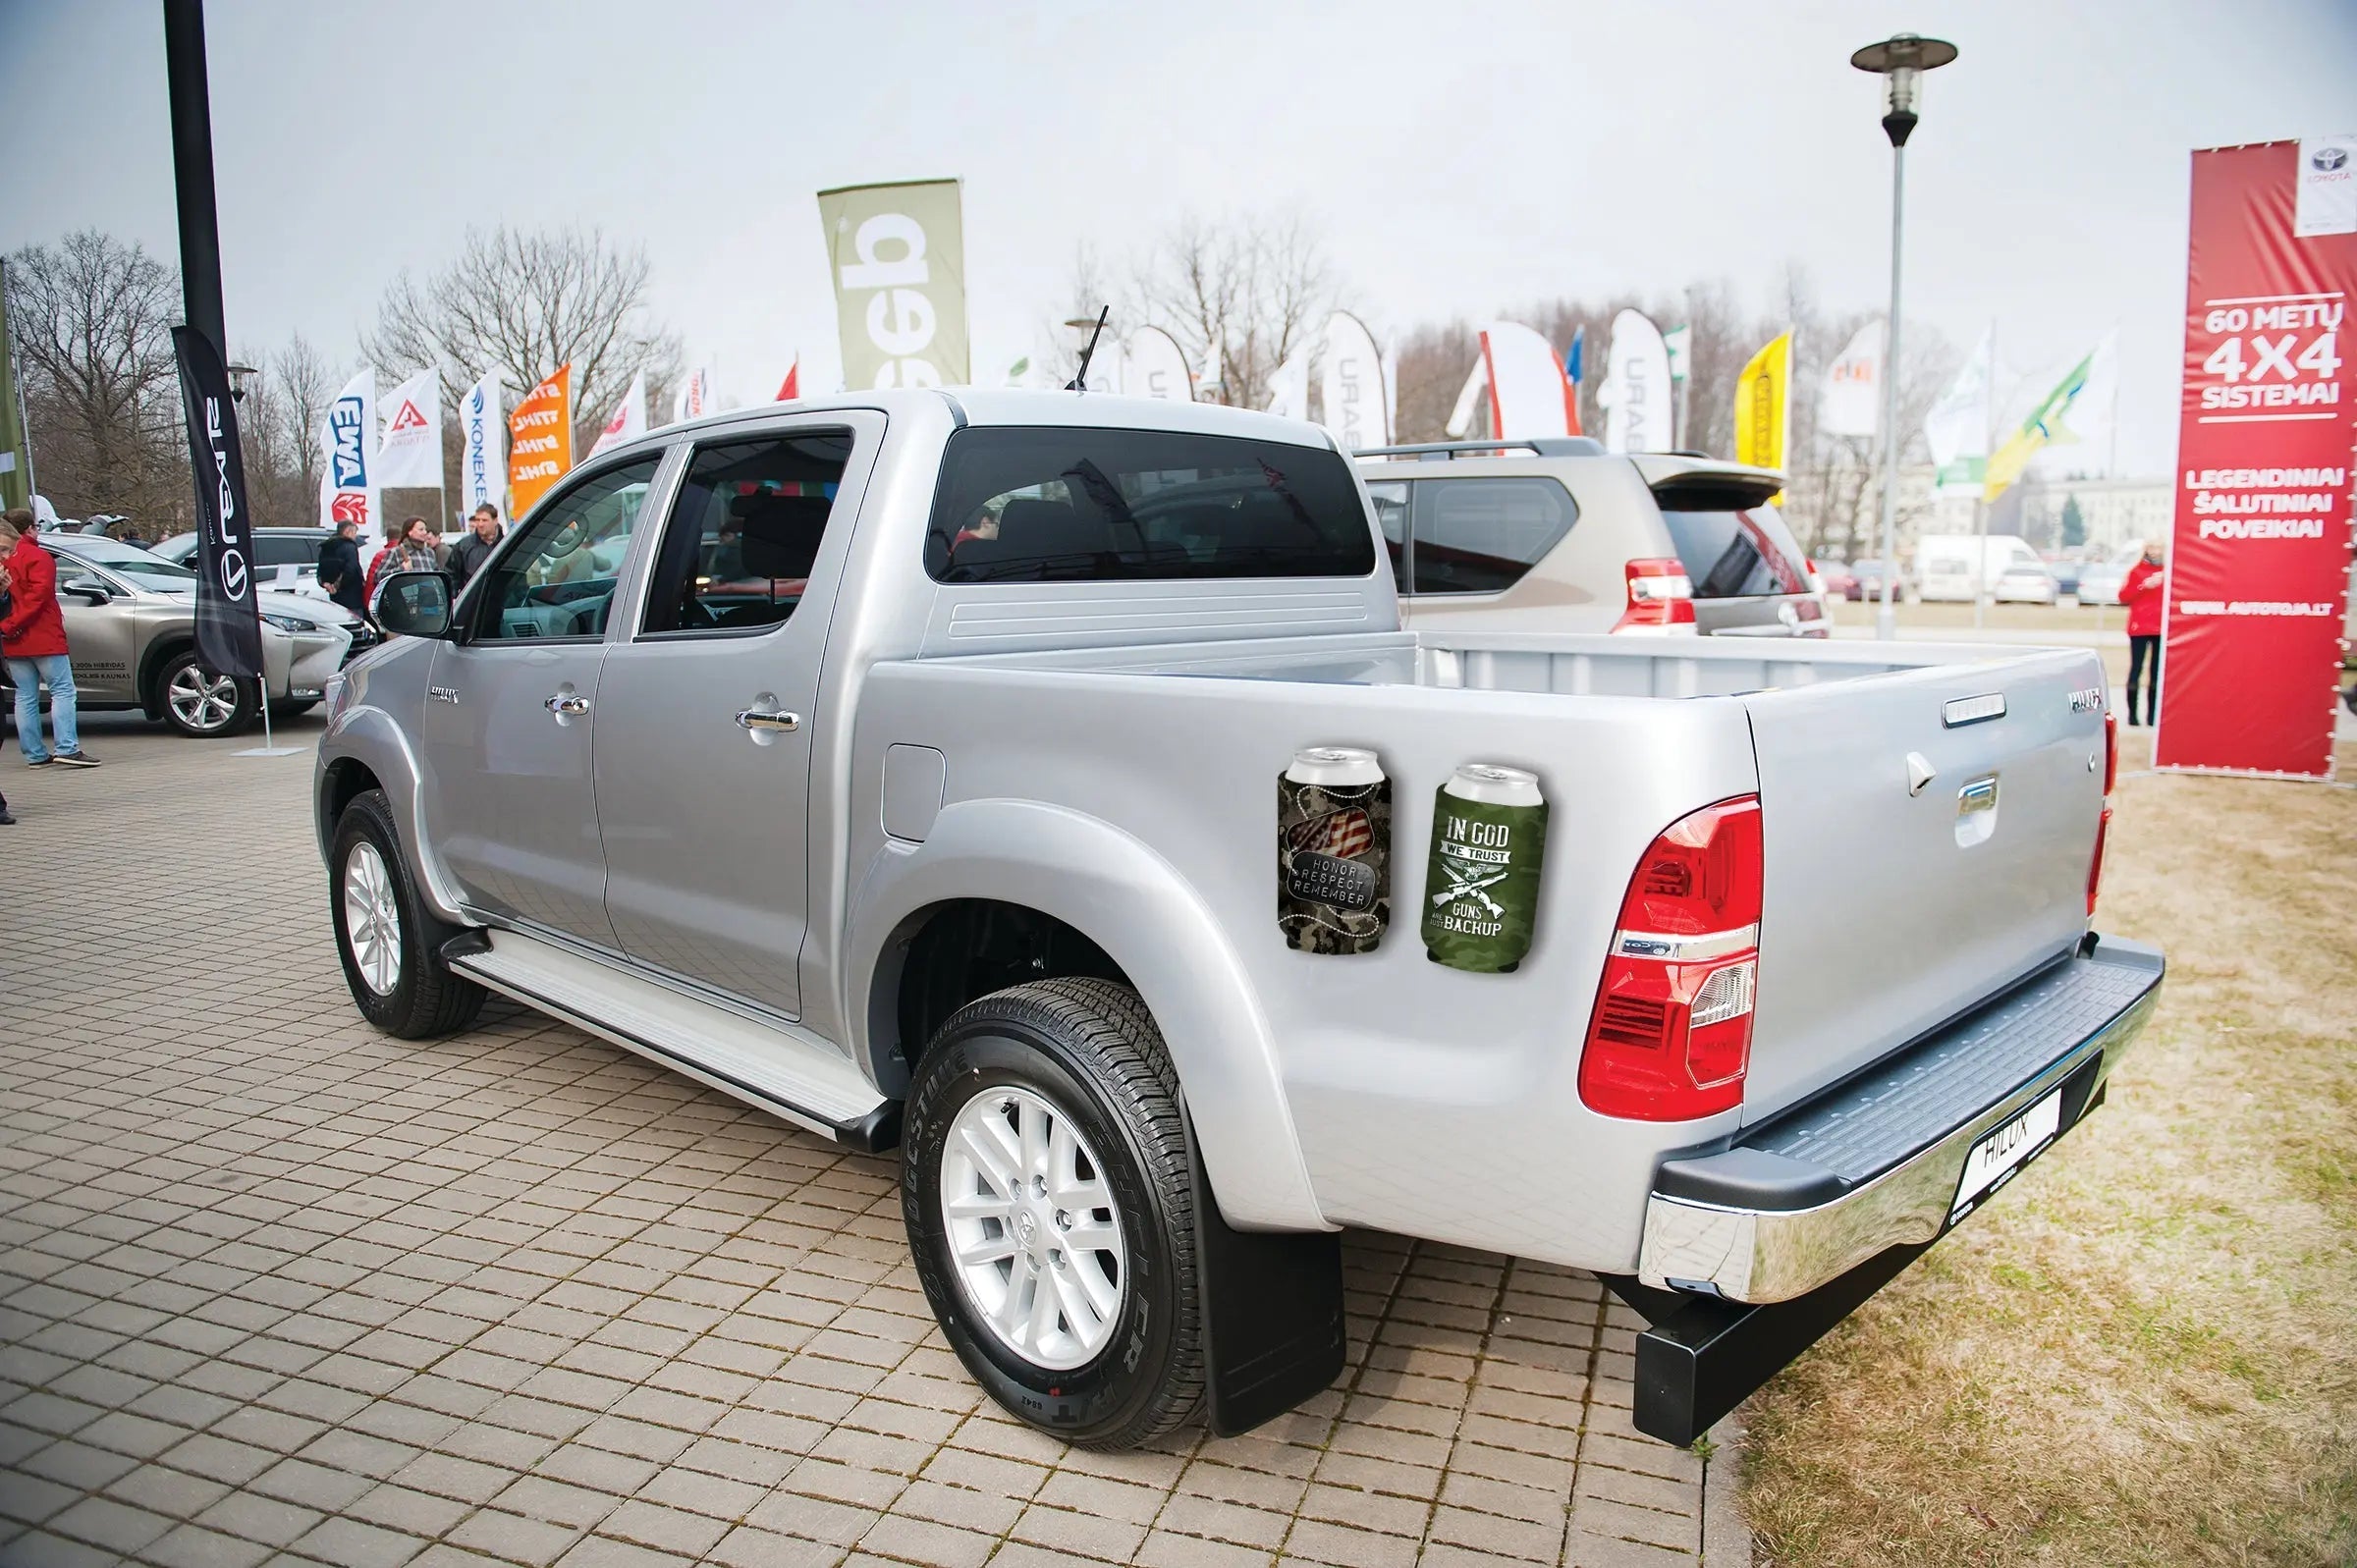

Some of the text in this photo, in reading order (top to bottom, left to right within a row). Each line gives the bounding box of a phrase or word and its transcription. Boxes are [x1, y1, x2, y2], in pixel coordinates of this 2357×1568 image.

[2205, 308, 2248, 334] 60
[2200, 382, 2339, 409] SISTEMAI
[332, 401, 361, 486] EWA
[2185, 467, 2344, 489] LEGENDINIAI
[2199, 519, 2324, 539] POVEIKIAI
[1447, 815, 1509, 848] IN GOD
[1447, 843, 1506, 862] WE TRUST
[1313, 859, 1356, 878] HONOR
[1301, 869, 1363, 891] RESPECT
[1293, 880, 1364, 904] REMEMBER
[1453, 902, 1483, 920] GUNS
[1444, 915, 1503, 937] BACKUP
[1984, 1111, 2029, 1168] HILUX
